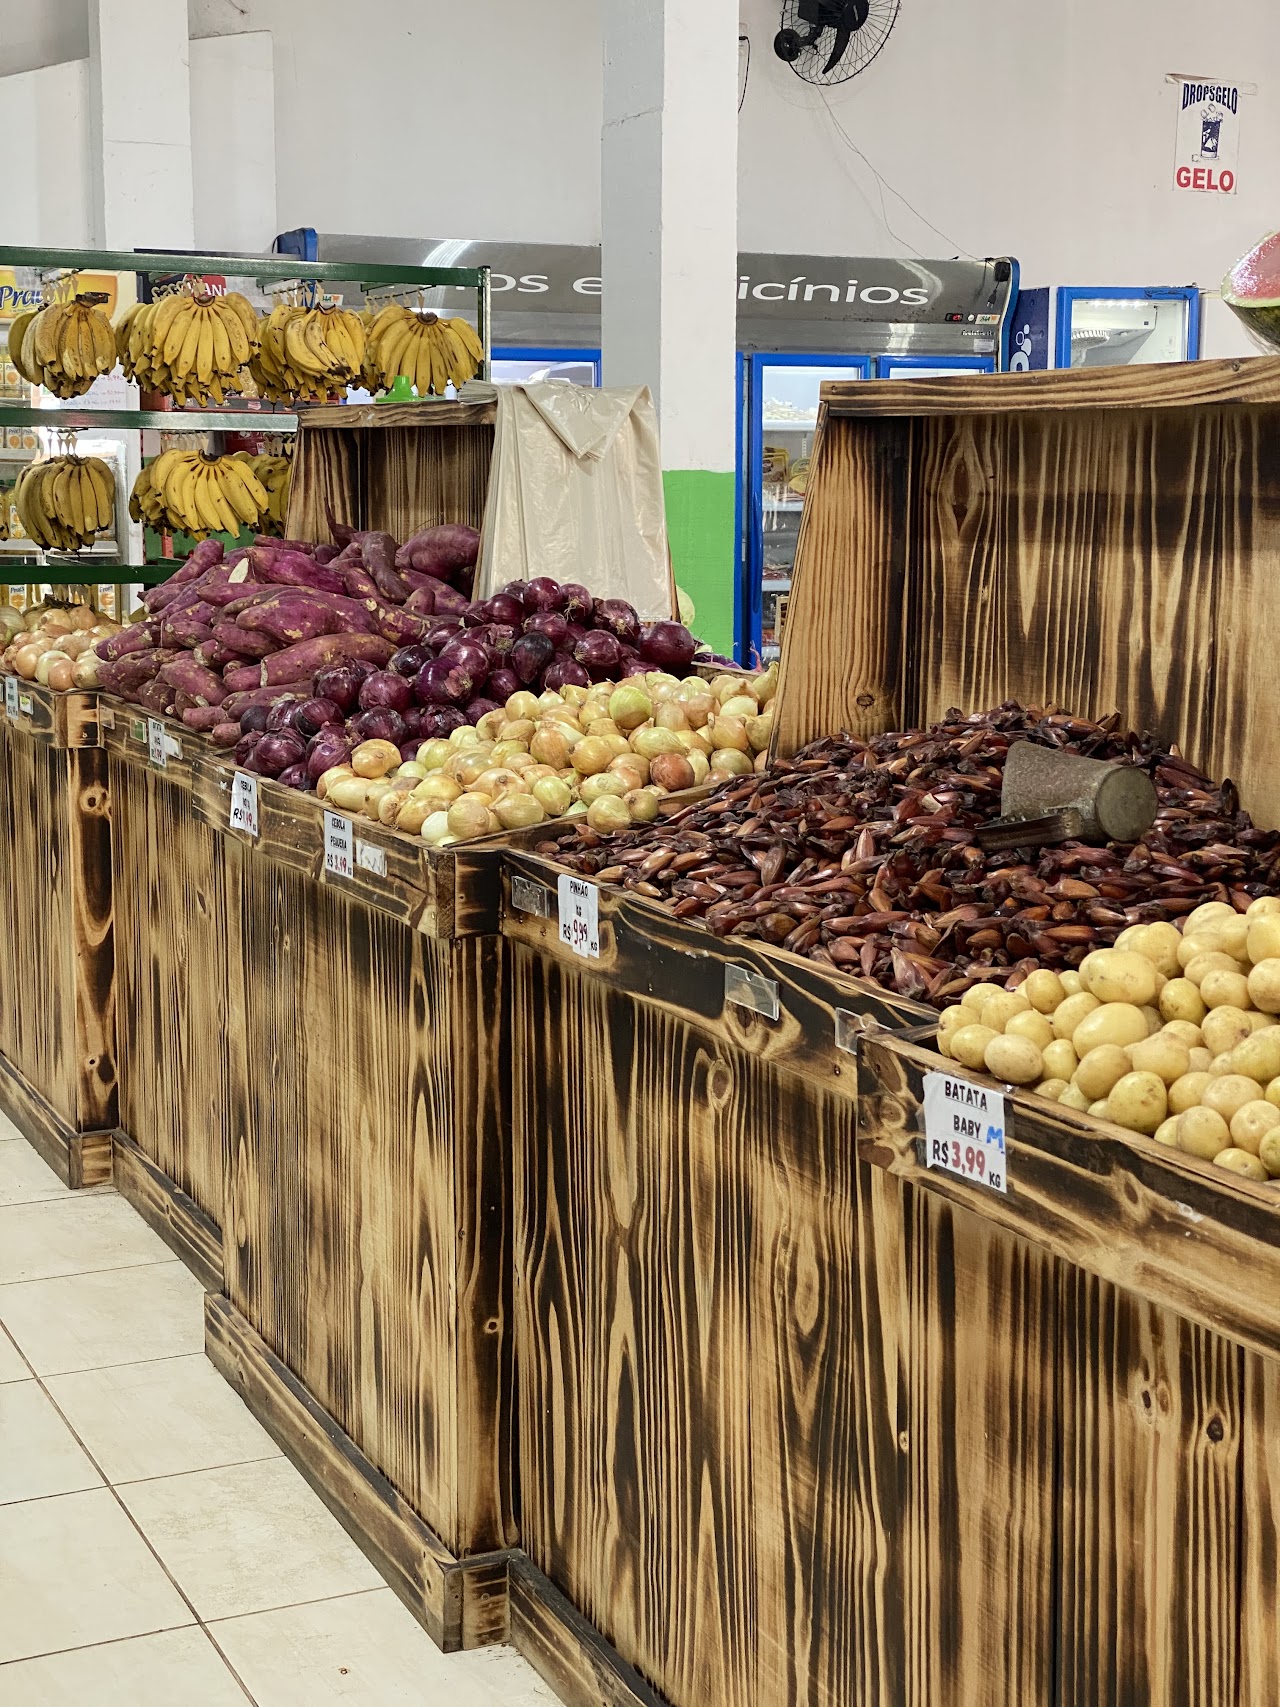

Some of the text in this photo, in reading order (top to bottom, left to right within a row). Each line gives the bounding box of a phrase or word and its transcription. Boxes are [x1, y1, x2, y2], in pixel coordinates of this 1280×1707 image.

[1181, 83, 1238, 115] DROPSGELO
[1176, 166, 1234, 192] GELO
[572, 277, 602, 294] e
[737, 275, 929, 305] icínios
[569, 880, 589, 897] PINHÃO
[944, 1080, 988, 1111] BATATA
[953, 1114, 982, 1139] BABY
[988, 1170, 1001, 1188] KG
